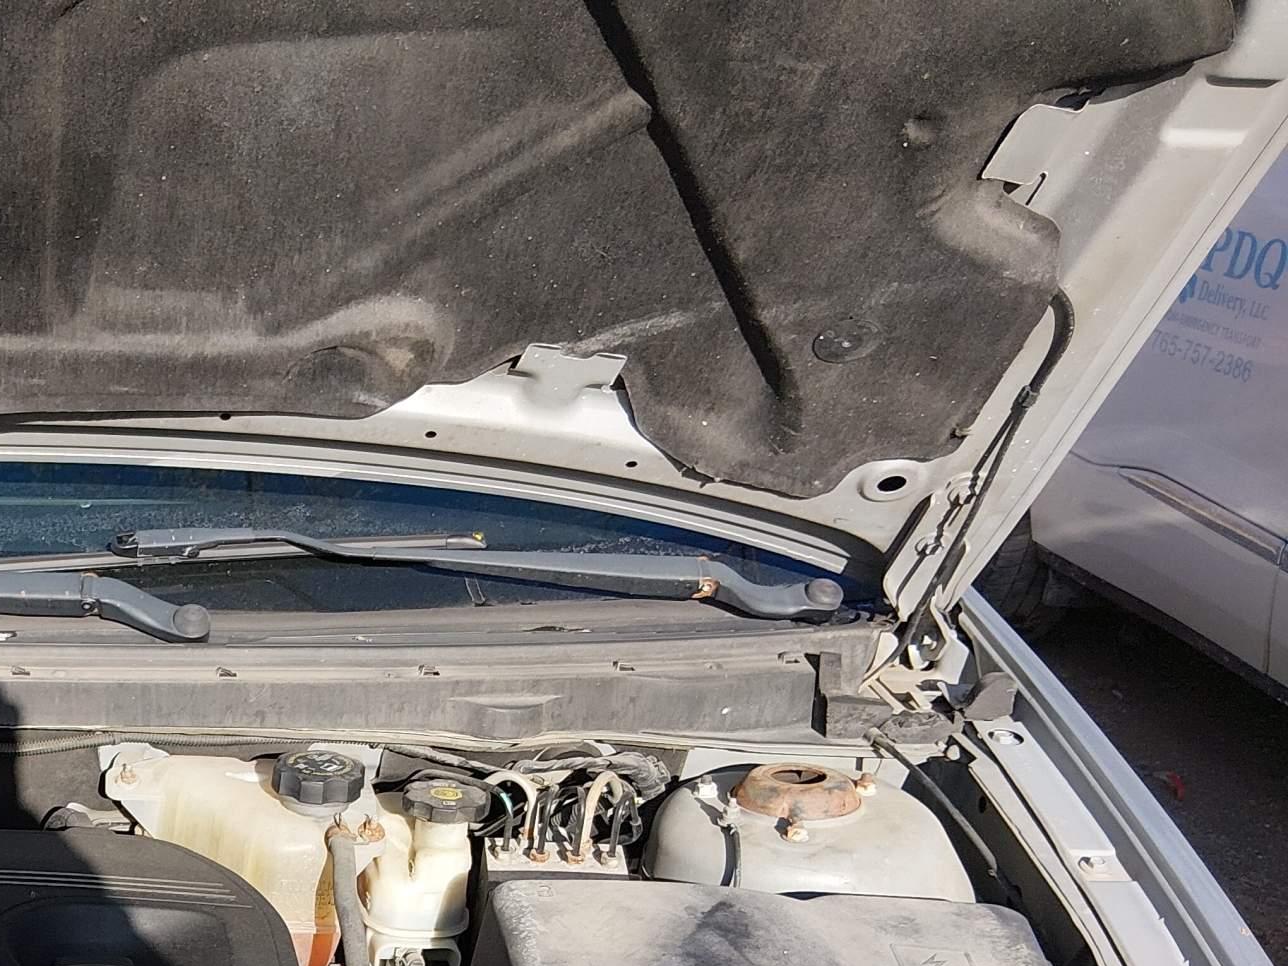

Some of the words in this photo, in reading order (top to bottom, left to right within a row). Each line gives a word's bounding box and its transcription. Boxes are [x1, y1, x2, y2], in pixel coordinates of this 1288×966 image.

[1200, 227, 1288, 290] PDQ
[1198, 281, 1247, 320] Delivery,
[1250, 300, 1271, 320] LLC
[1152, 330, 1254, 383] 765-757-2386
